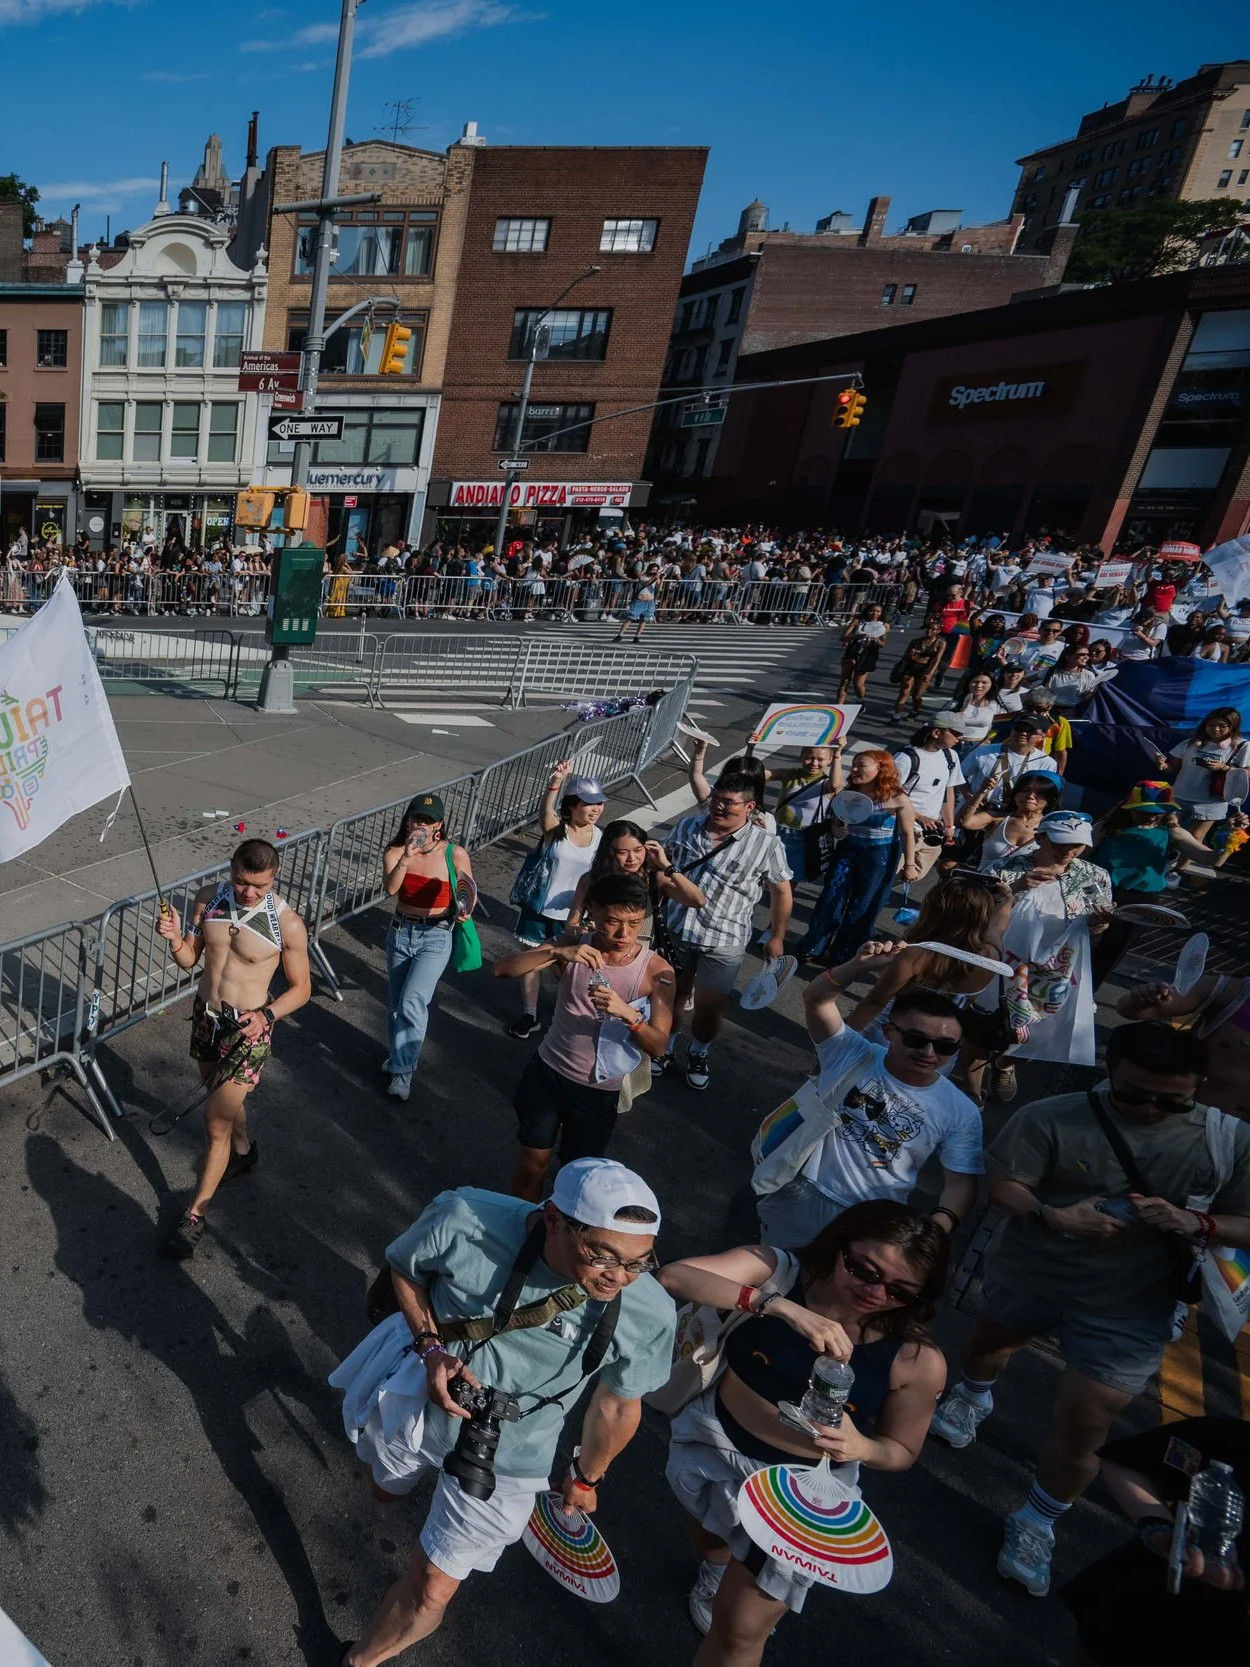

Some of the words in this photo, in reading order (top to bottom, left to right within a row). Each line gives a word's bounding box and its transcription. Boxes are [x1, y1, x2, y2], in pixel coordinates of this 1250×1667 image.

[242, 361, 279, 371] Americas
[258, 378, 265, 390] 6
[267, 378, 280, 390] Av
[274, 391, 296, 403] Greenwich
[949, 379, 1046, 410] Spectrum
[1177, 389, 1241, 404] Spectrum
[279, 423, 301, 433] ONE
[310, 423, 334, 433] WAY
[306, 469, 385, 489] luemercury
[524, 485, 567, 505] PIZZA
[206, 516, 230, 527] OPEN
[771, 1544, 838, 1584] TAIWAN
[544, 1560, 587, 1595] TAIWAN
